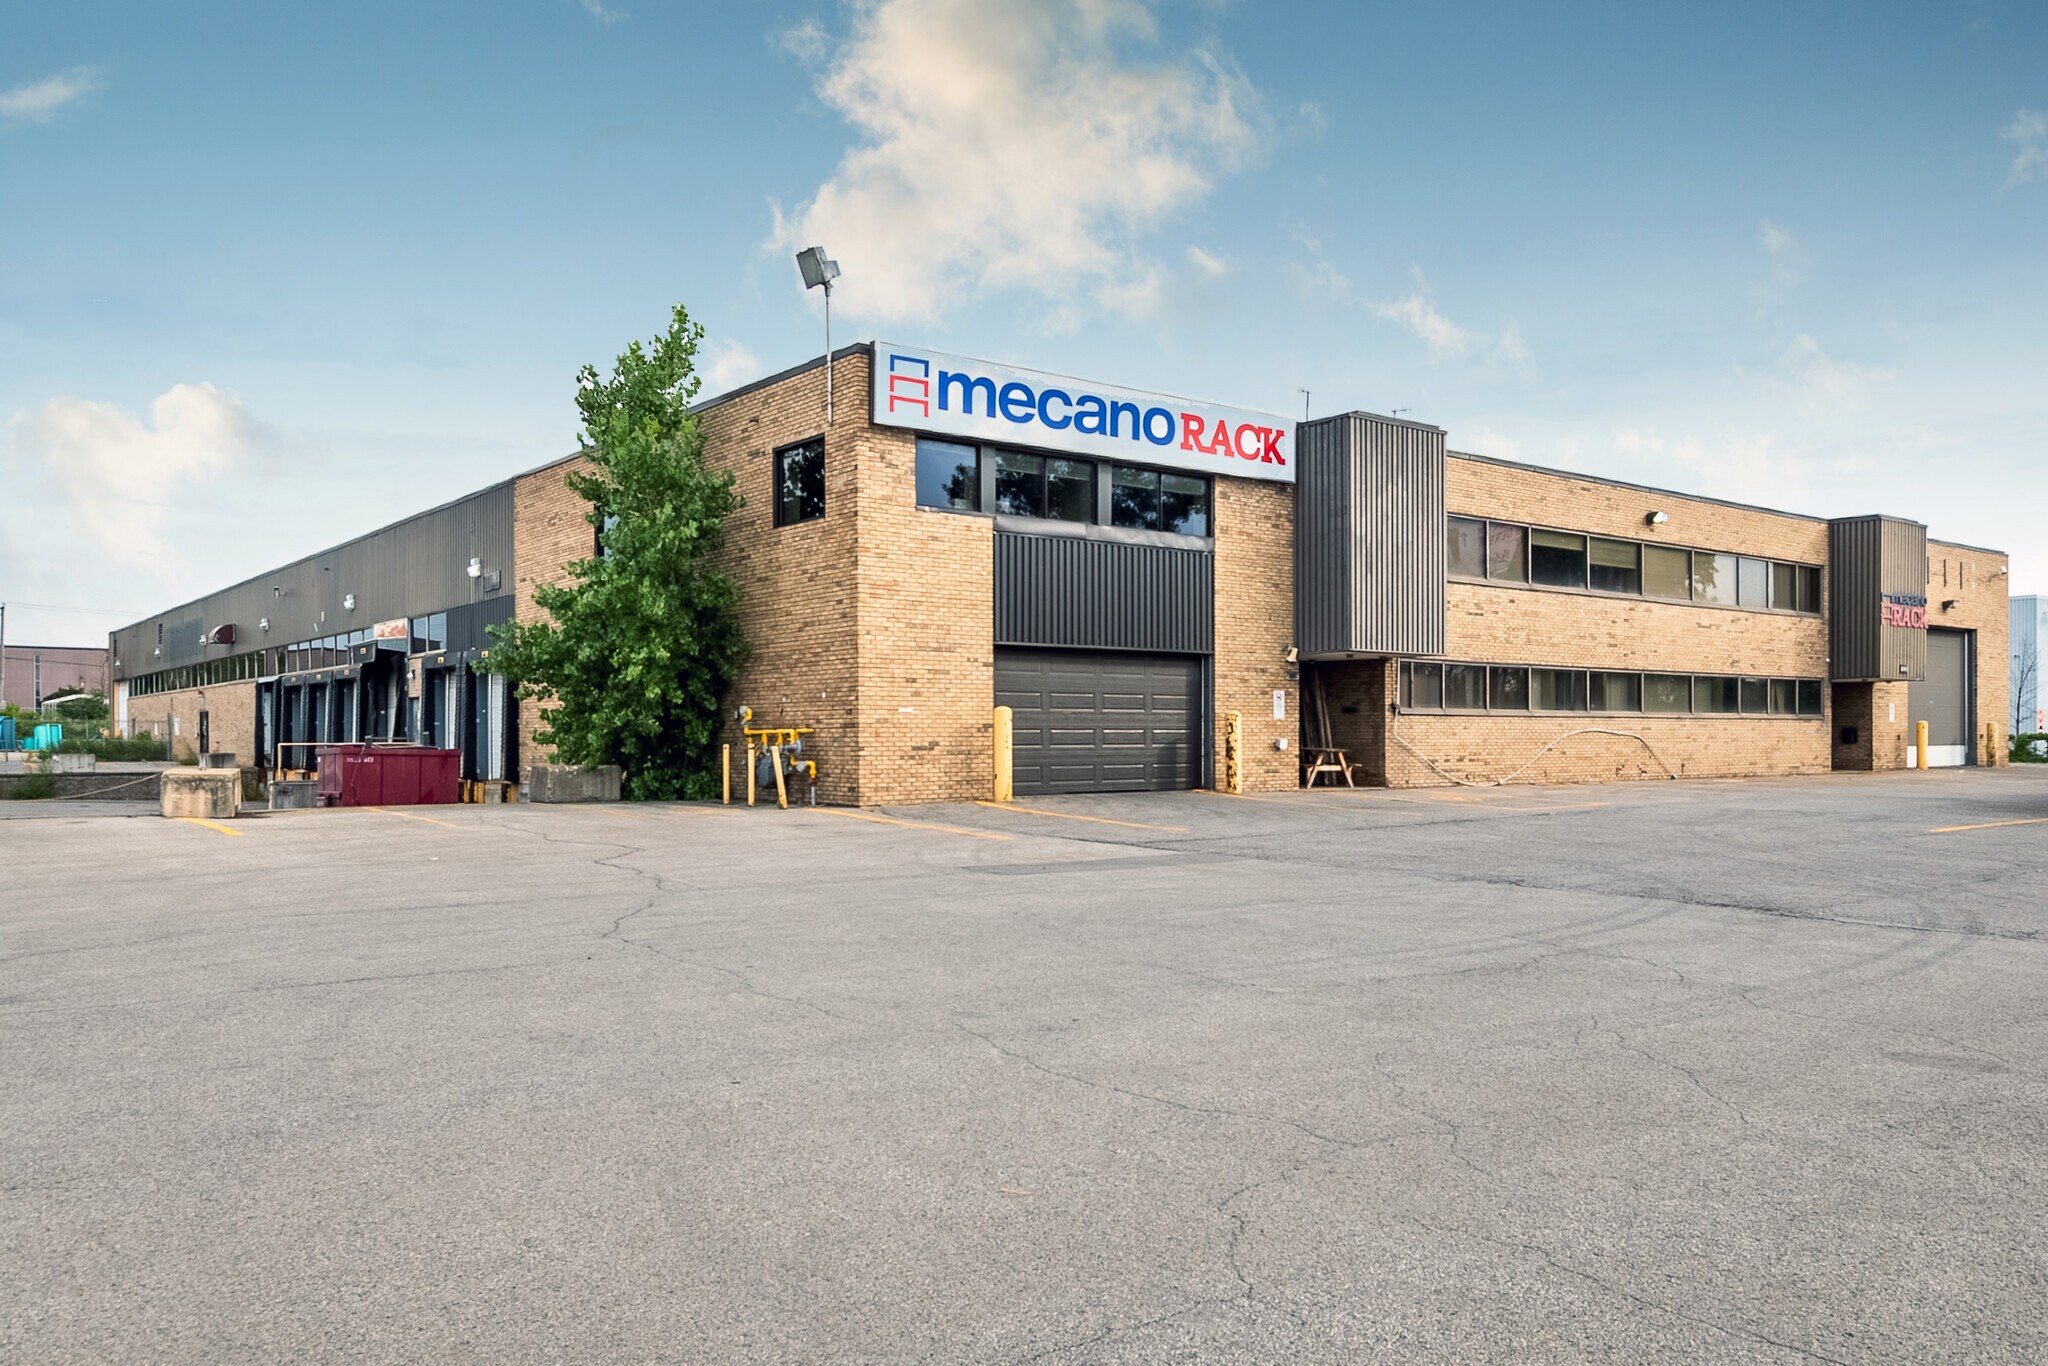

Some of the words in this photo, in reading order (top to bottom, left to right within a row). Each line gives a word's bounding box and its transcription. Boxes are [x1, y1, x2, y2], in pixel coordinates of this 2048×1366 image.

[938, 370, 1176, 446] mecano
[1180, 412, 1286, 465] RACK
[1891, 605, 1928, 629] RACK
